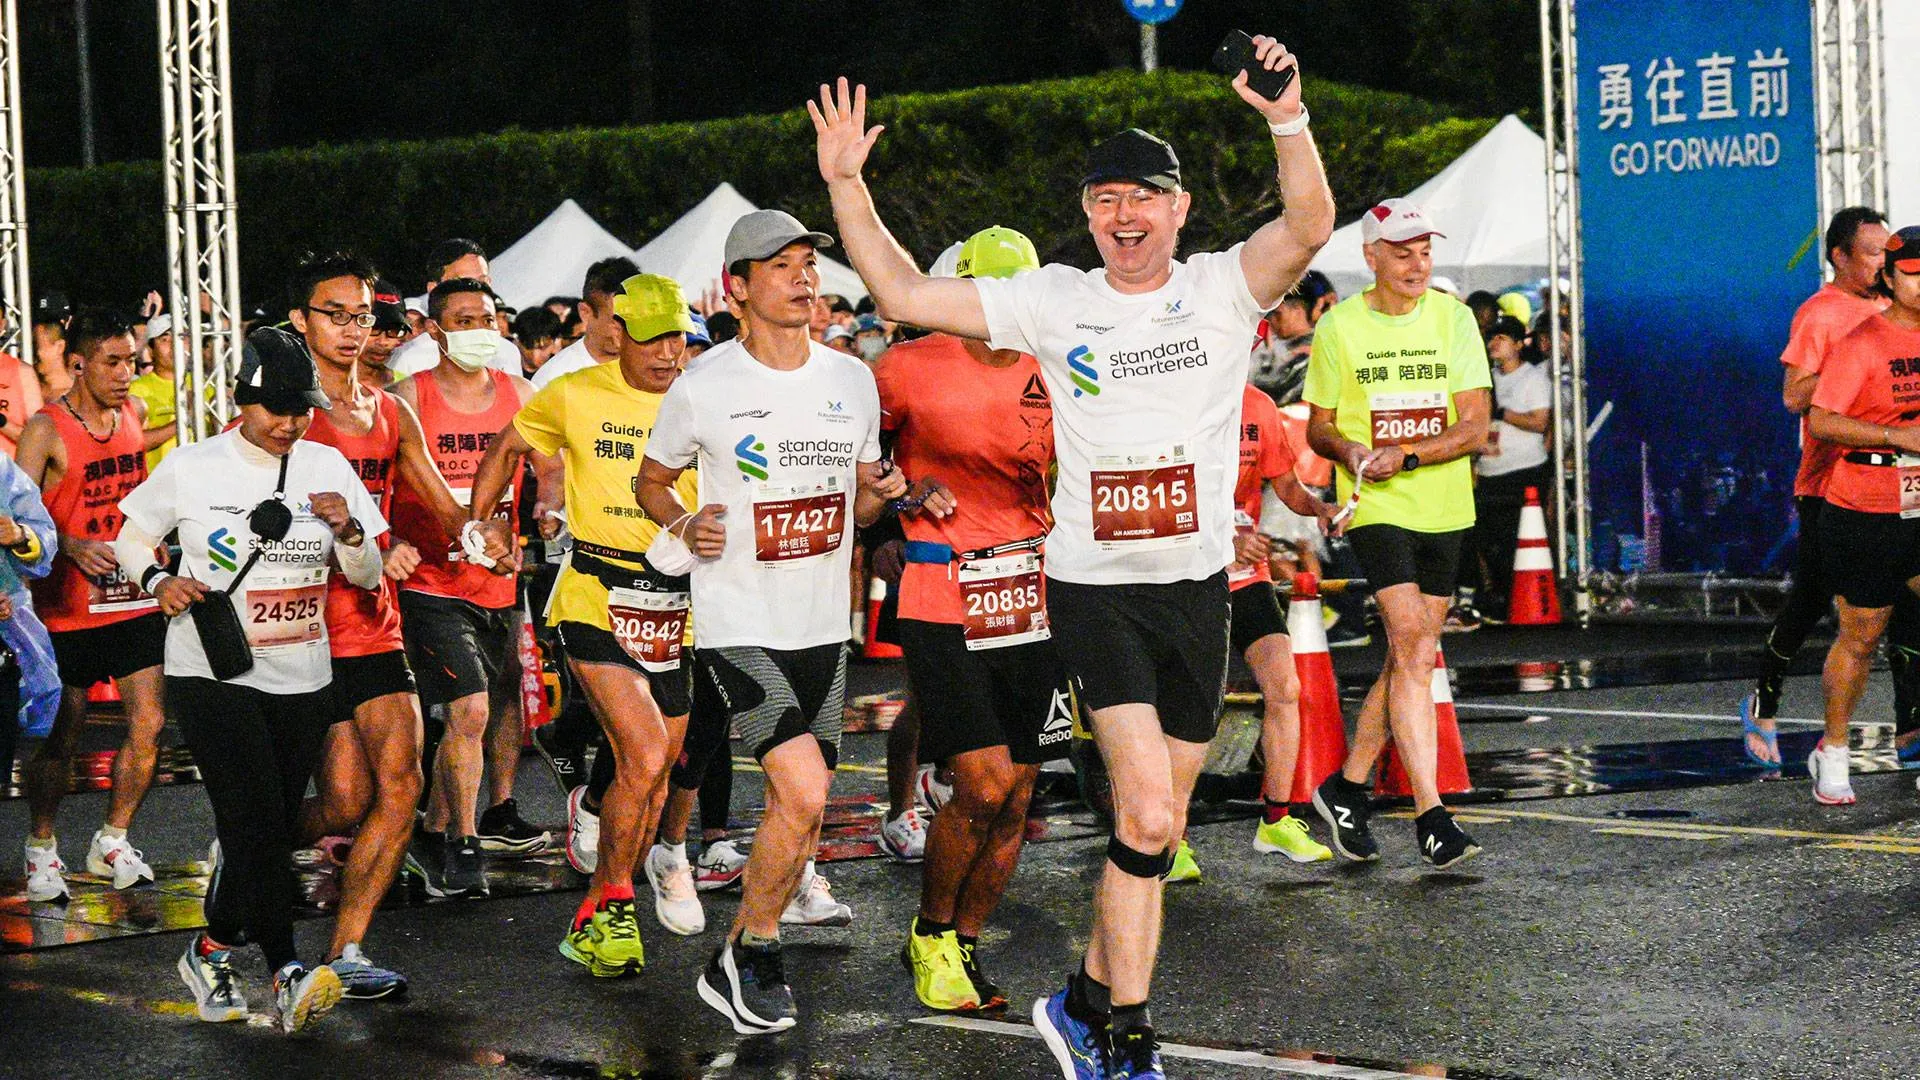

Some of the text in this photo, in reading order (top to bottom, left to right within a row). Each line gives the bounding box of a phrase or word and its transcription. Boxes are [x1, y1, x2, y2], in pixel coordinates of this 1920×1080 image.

[1598, 47, 1790, 131] 勇往直前
[1610, 132, 1780, 176] GO FORWARD
[1109, 337, 1199, 367] standard
[1366, 349, 1437, 360] Guide Runner
[1111, 352, 1208, 379] chartered
[1355, 363, 1447, 384] 視障 陪跑員
[730, 409, 763, 419] saucony
[602, 421, 643, 438] Guide
[1375, 417, 1442, 439] 20846
[594, 438, 635, 461] 視障
[778, 439, 853, 454] standard
[779, 453, 853, 467] chartered
[1096, 479, 1188, 512] 20815
[761, 506, 838, 538] 17427
[248, 537, 322, 550] standard
[253, 597, 318, 624] 24525
[966, 584, 1039, 617] 20835
[613, 617, 681, 641] 20842
[1038, 729, 1073, 747] Reebo
